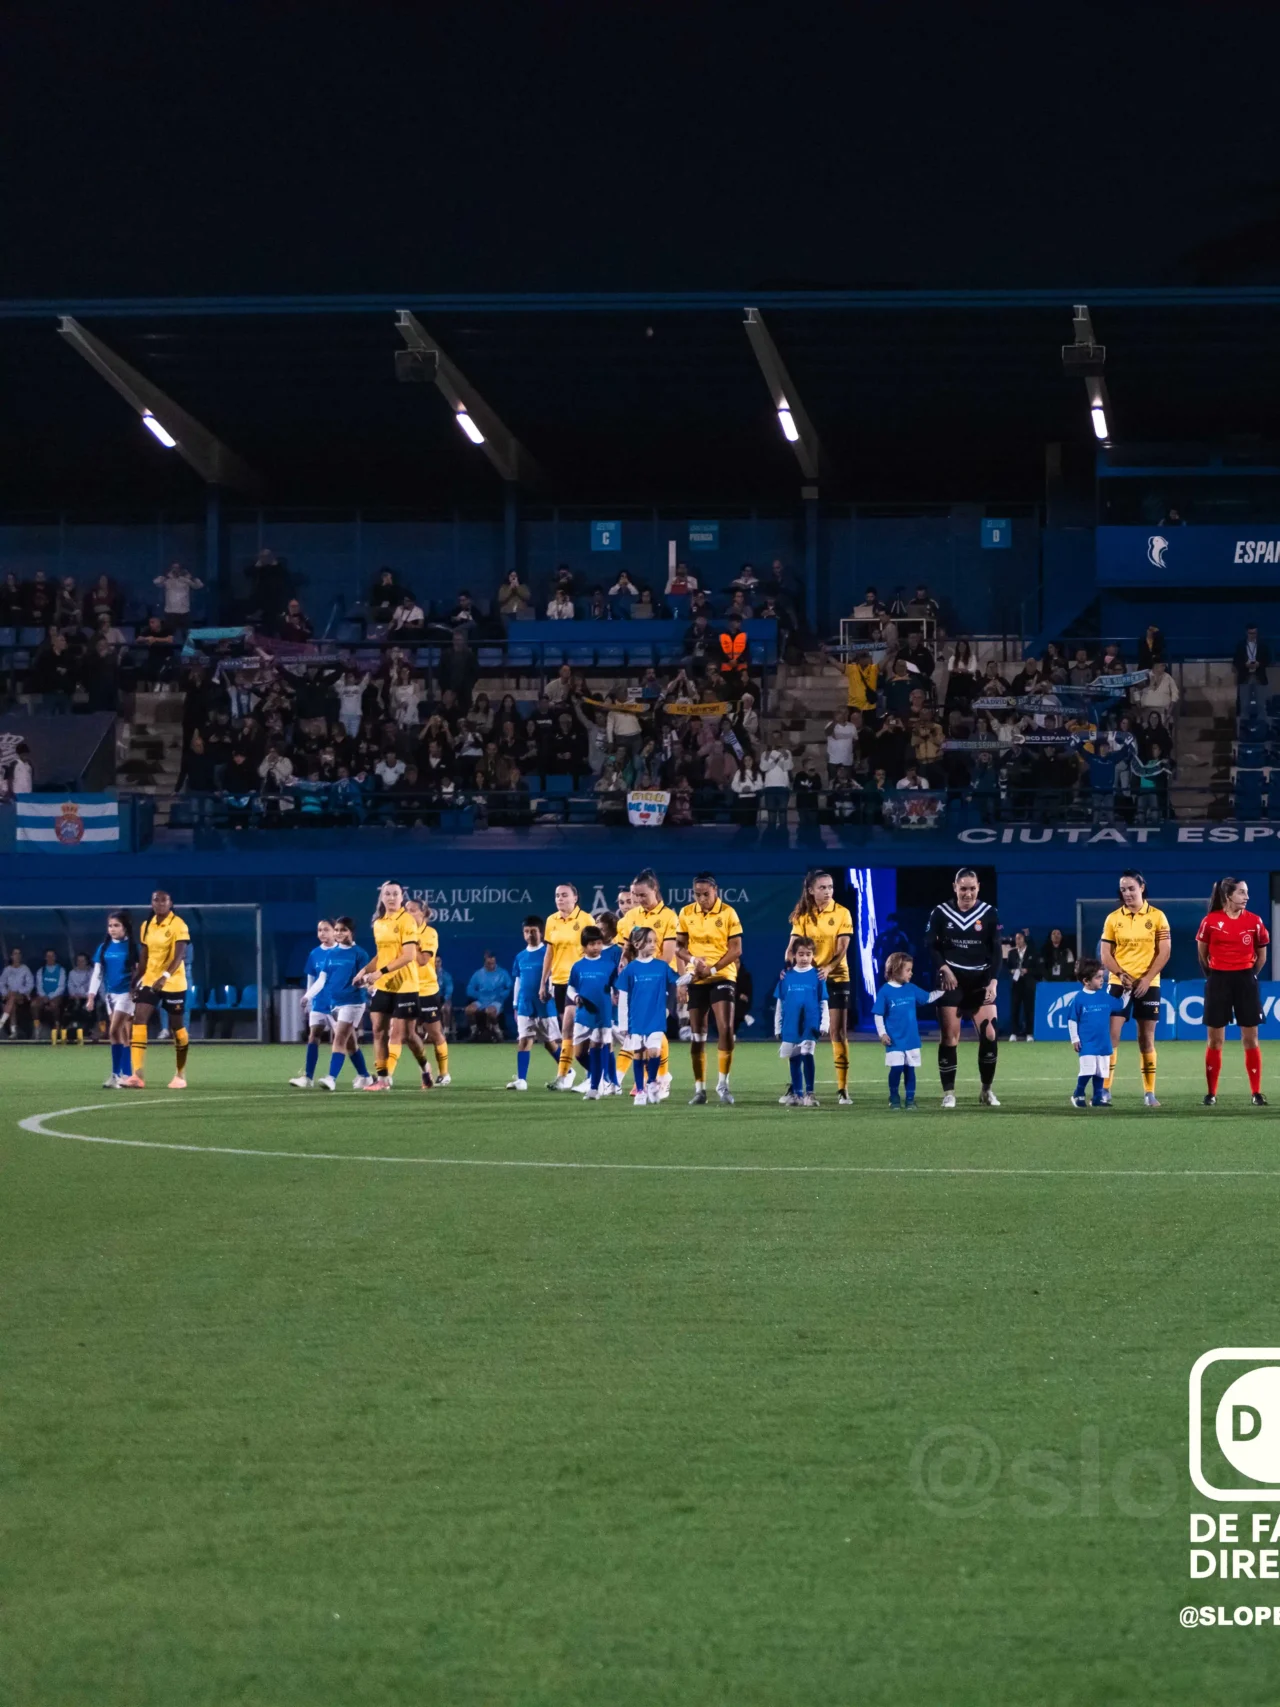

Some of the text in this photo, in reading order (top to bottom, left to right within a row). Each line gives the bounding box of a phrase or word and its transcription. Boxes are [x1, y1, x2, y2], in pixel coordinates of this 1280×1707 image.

[602, 532, 610, 546] C
[958, 826, 1161, 844] CIUTAT
[450, 886, 532, 906] JURÍDICA
